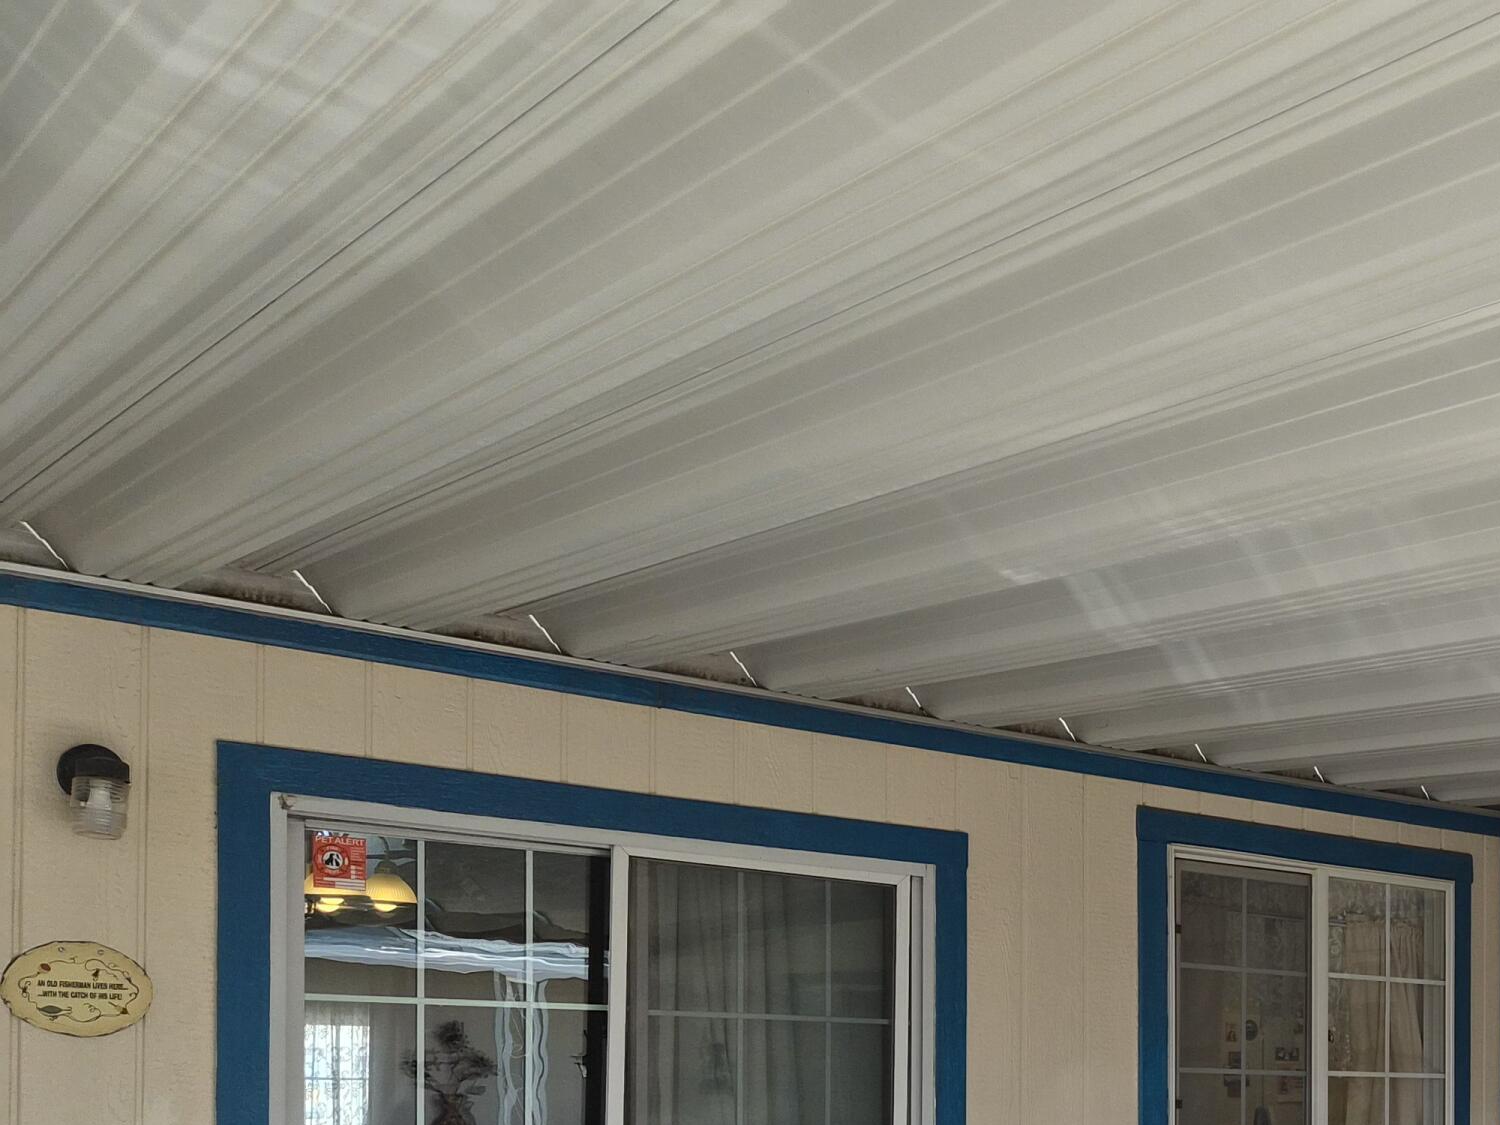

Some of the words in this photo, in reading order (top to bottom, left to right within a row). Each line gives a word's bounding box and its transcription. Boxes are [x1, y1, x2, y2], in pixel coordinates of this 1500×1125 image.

[315, 835, 332, 844] PET
[335, 837, 365, 846] ALERT
[60, 981, 91, 989] FISHERMAN
